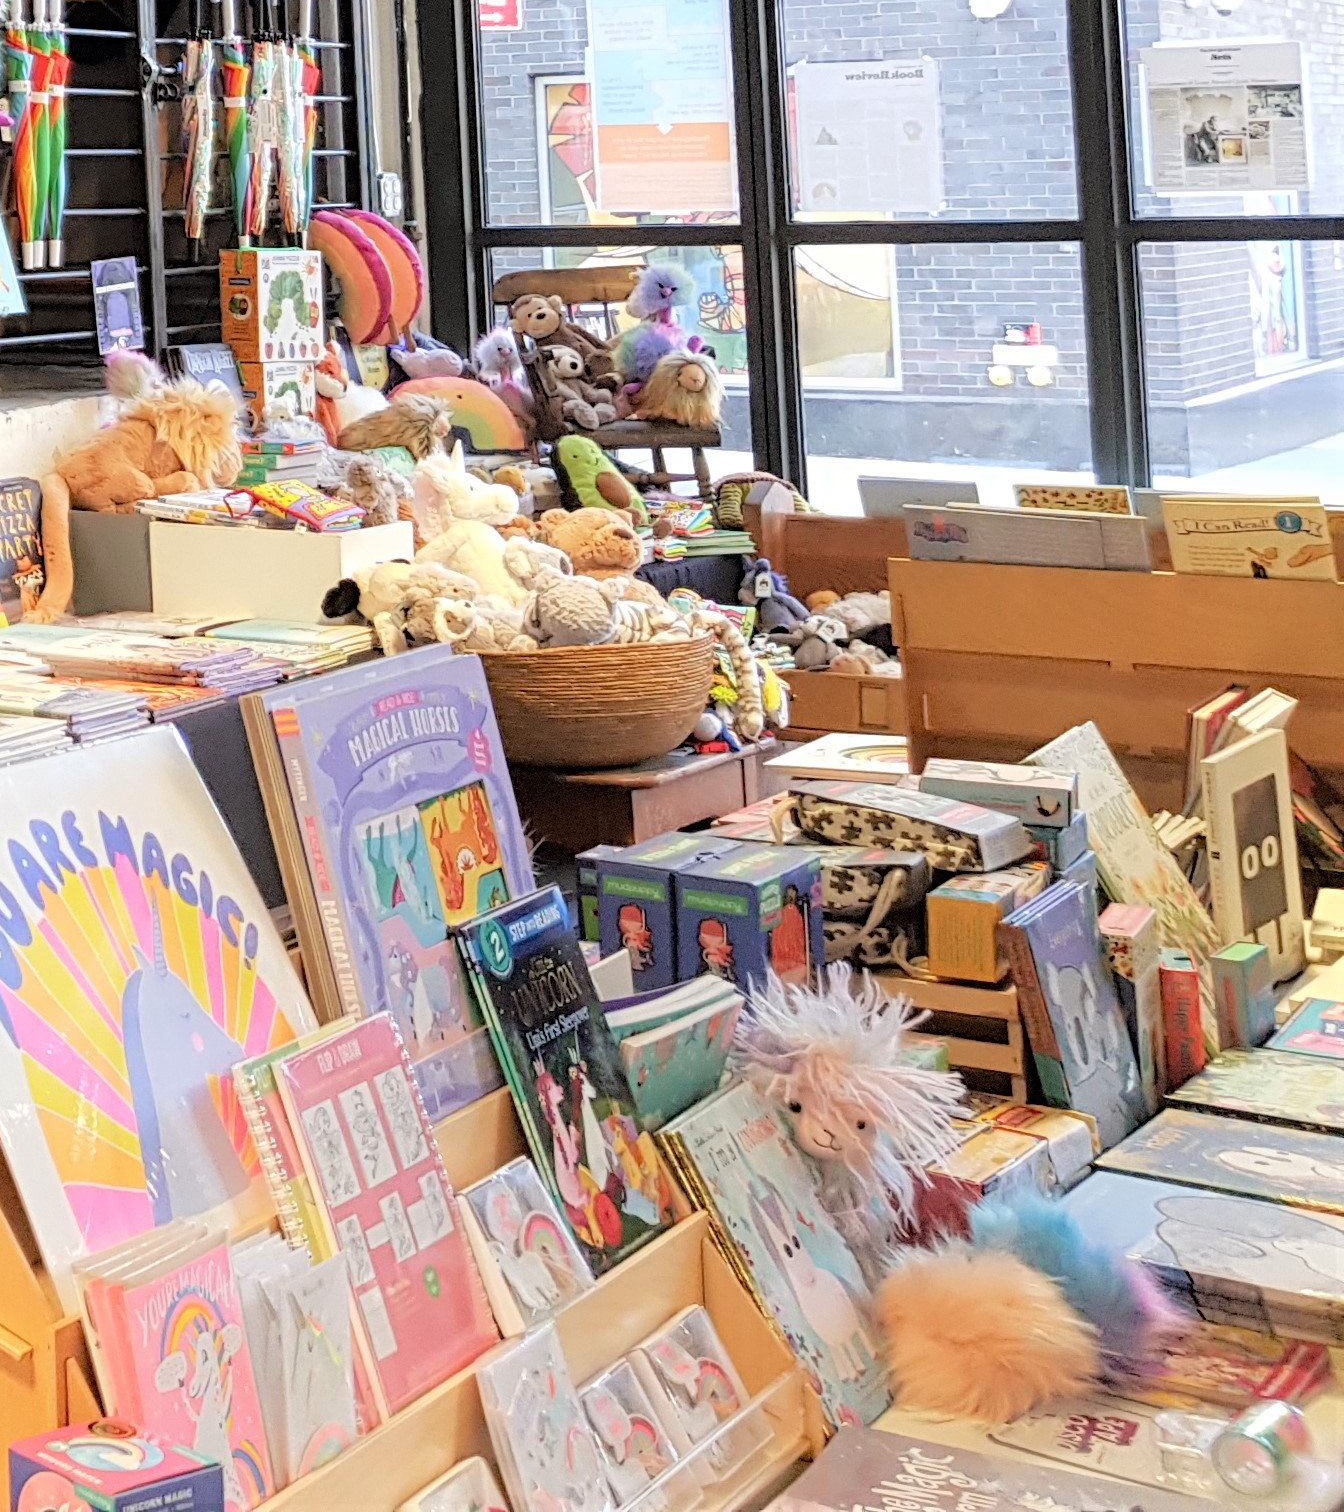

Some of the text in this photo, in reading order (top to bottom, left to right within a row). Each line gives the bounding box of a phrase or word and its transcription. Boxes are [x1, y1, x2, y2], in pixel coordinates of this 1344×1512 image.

[1203, 522, 1230, 531] Can
[1233, 518, 1270, 530] Read!
[348, 704, 460, 767] MAGICAL HORSES
[8, 809, 99, 921] ARE
[97, 809, 259, 970] MAGIC!
[490, 933, 505, 958] 2
[510, 921, 527, 942] STEP
[165, 1488, 195, 1504] MAGIC
